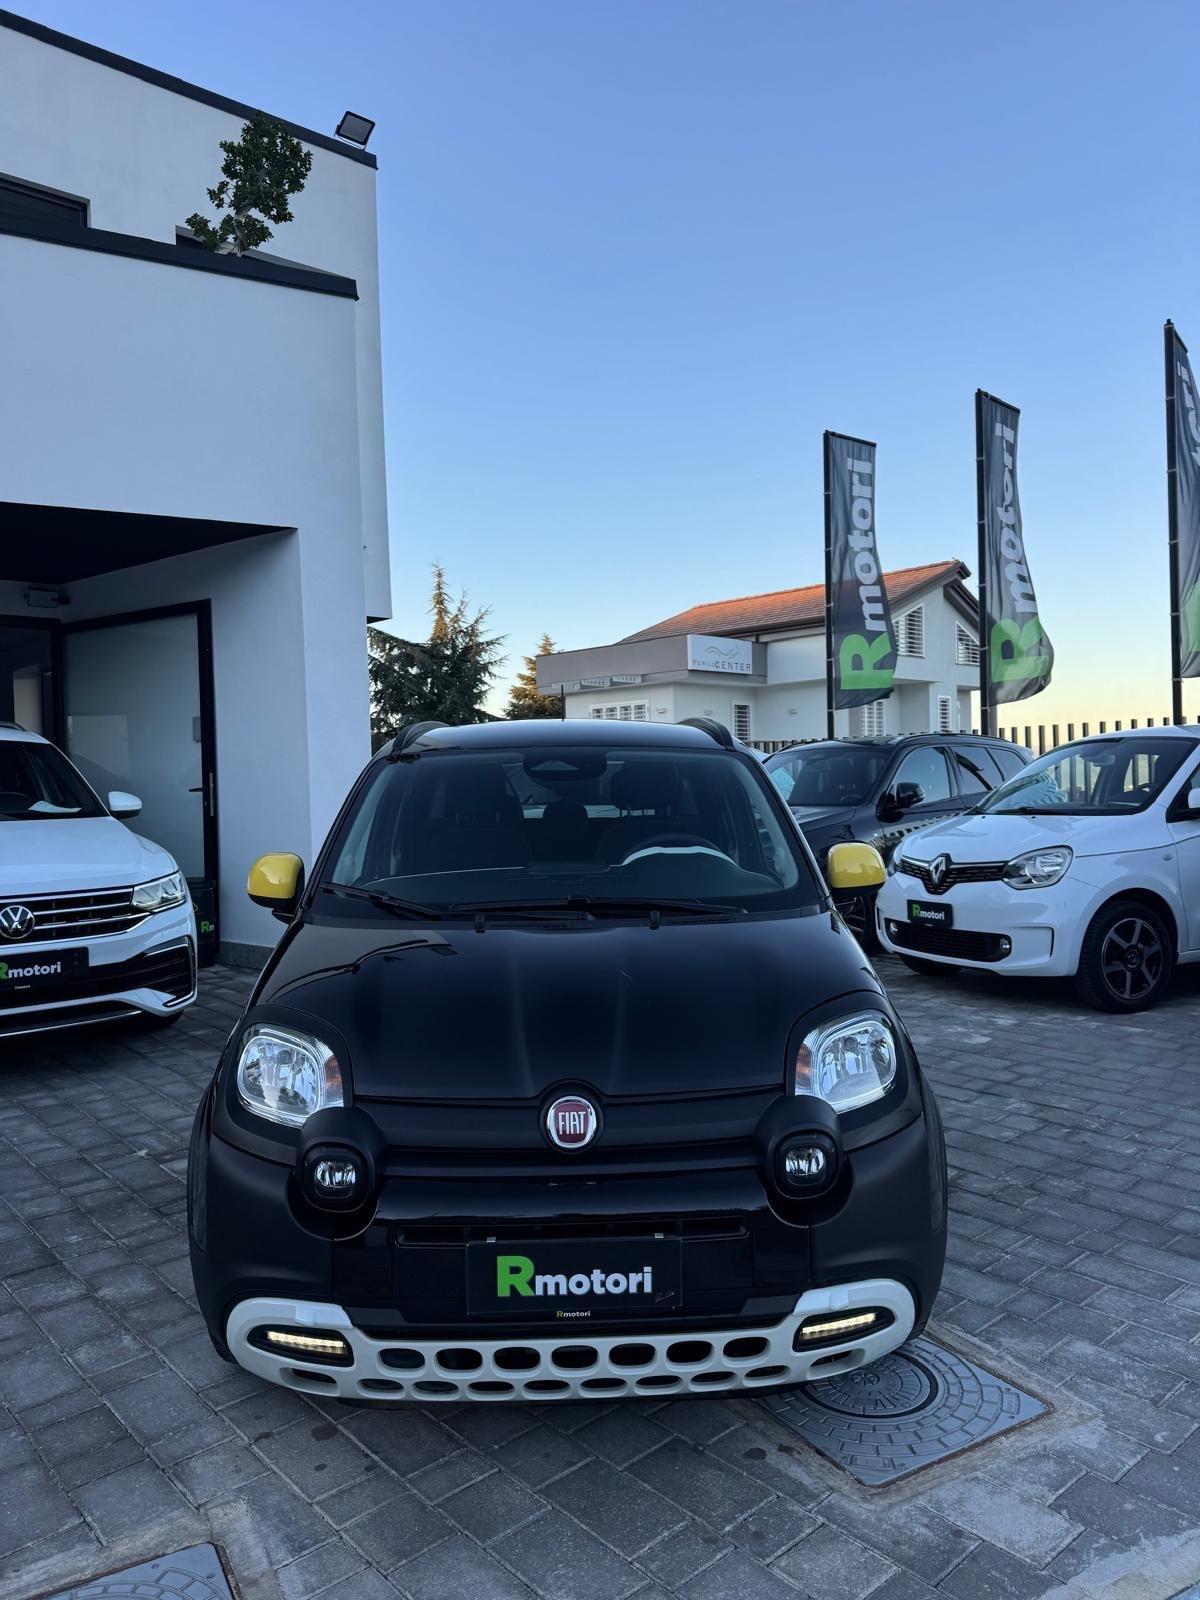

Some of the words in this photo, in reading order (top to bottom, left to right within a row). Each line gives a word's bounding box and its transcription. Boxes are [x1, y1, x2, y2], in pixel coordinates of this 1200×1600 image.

[990, 421, 1049, 684] Rmotori
[839, 457, 894, 690] Rmotori
[912, 903, 945, 920] Rmotori
[558, 1111, 586, 1135] FIAT
[497, 1255, 652, 1297] Rmotori
[556, 1310, 591, 1318] Rmotori
